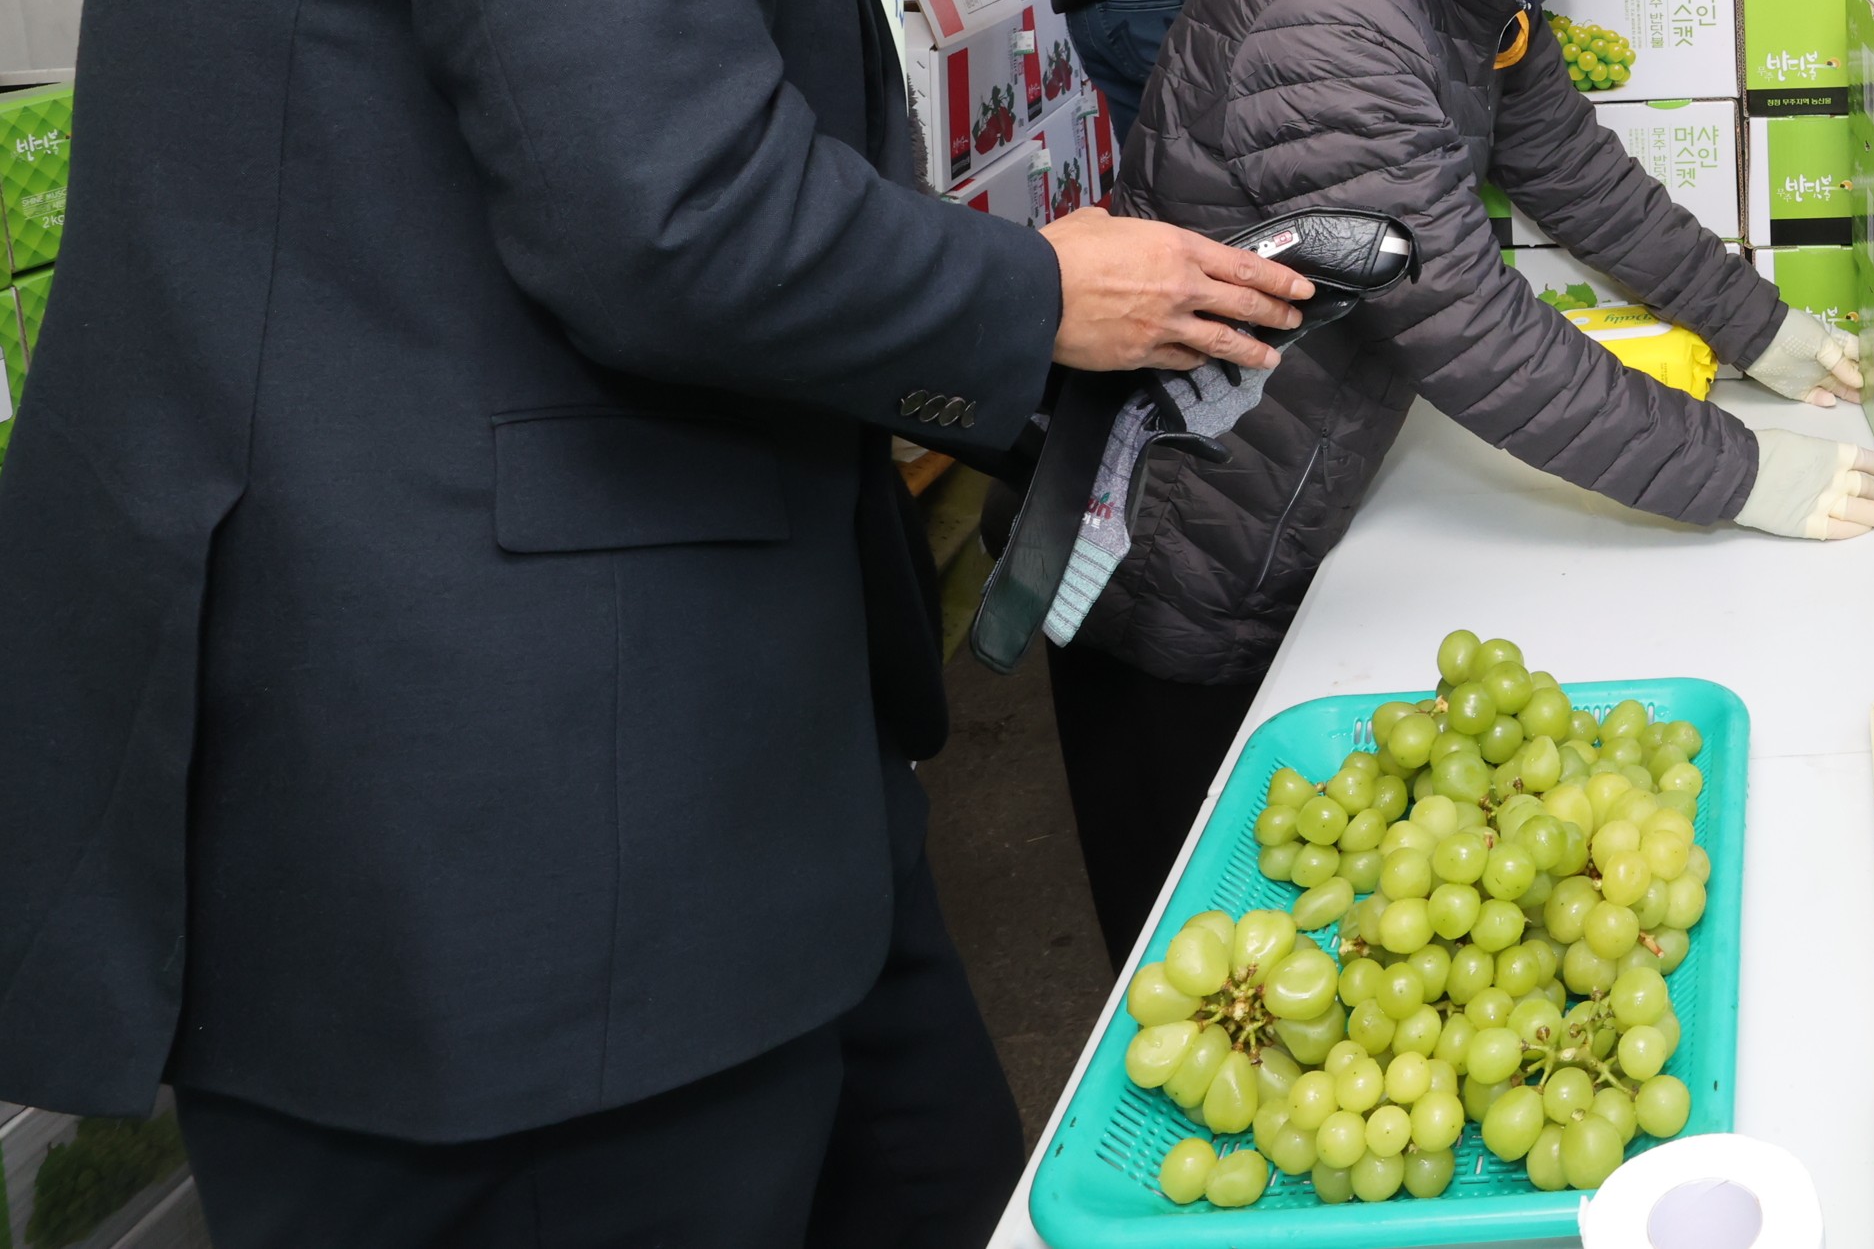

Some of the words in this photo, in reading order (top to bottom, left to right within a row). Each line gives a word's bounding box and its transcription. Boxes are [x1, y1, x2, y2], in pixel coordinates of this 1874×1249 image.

[1766, 50, 1820, 81] 반딧불
[1652, 127, 1665, 150] 무주
[1697, 125, 1719, 168] 샤인
[46, 188, 68, 200] MUSC
[1785, 174, 1832, 202] 반딧불
